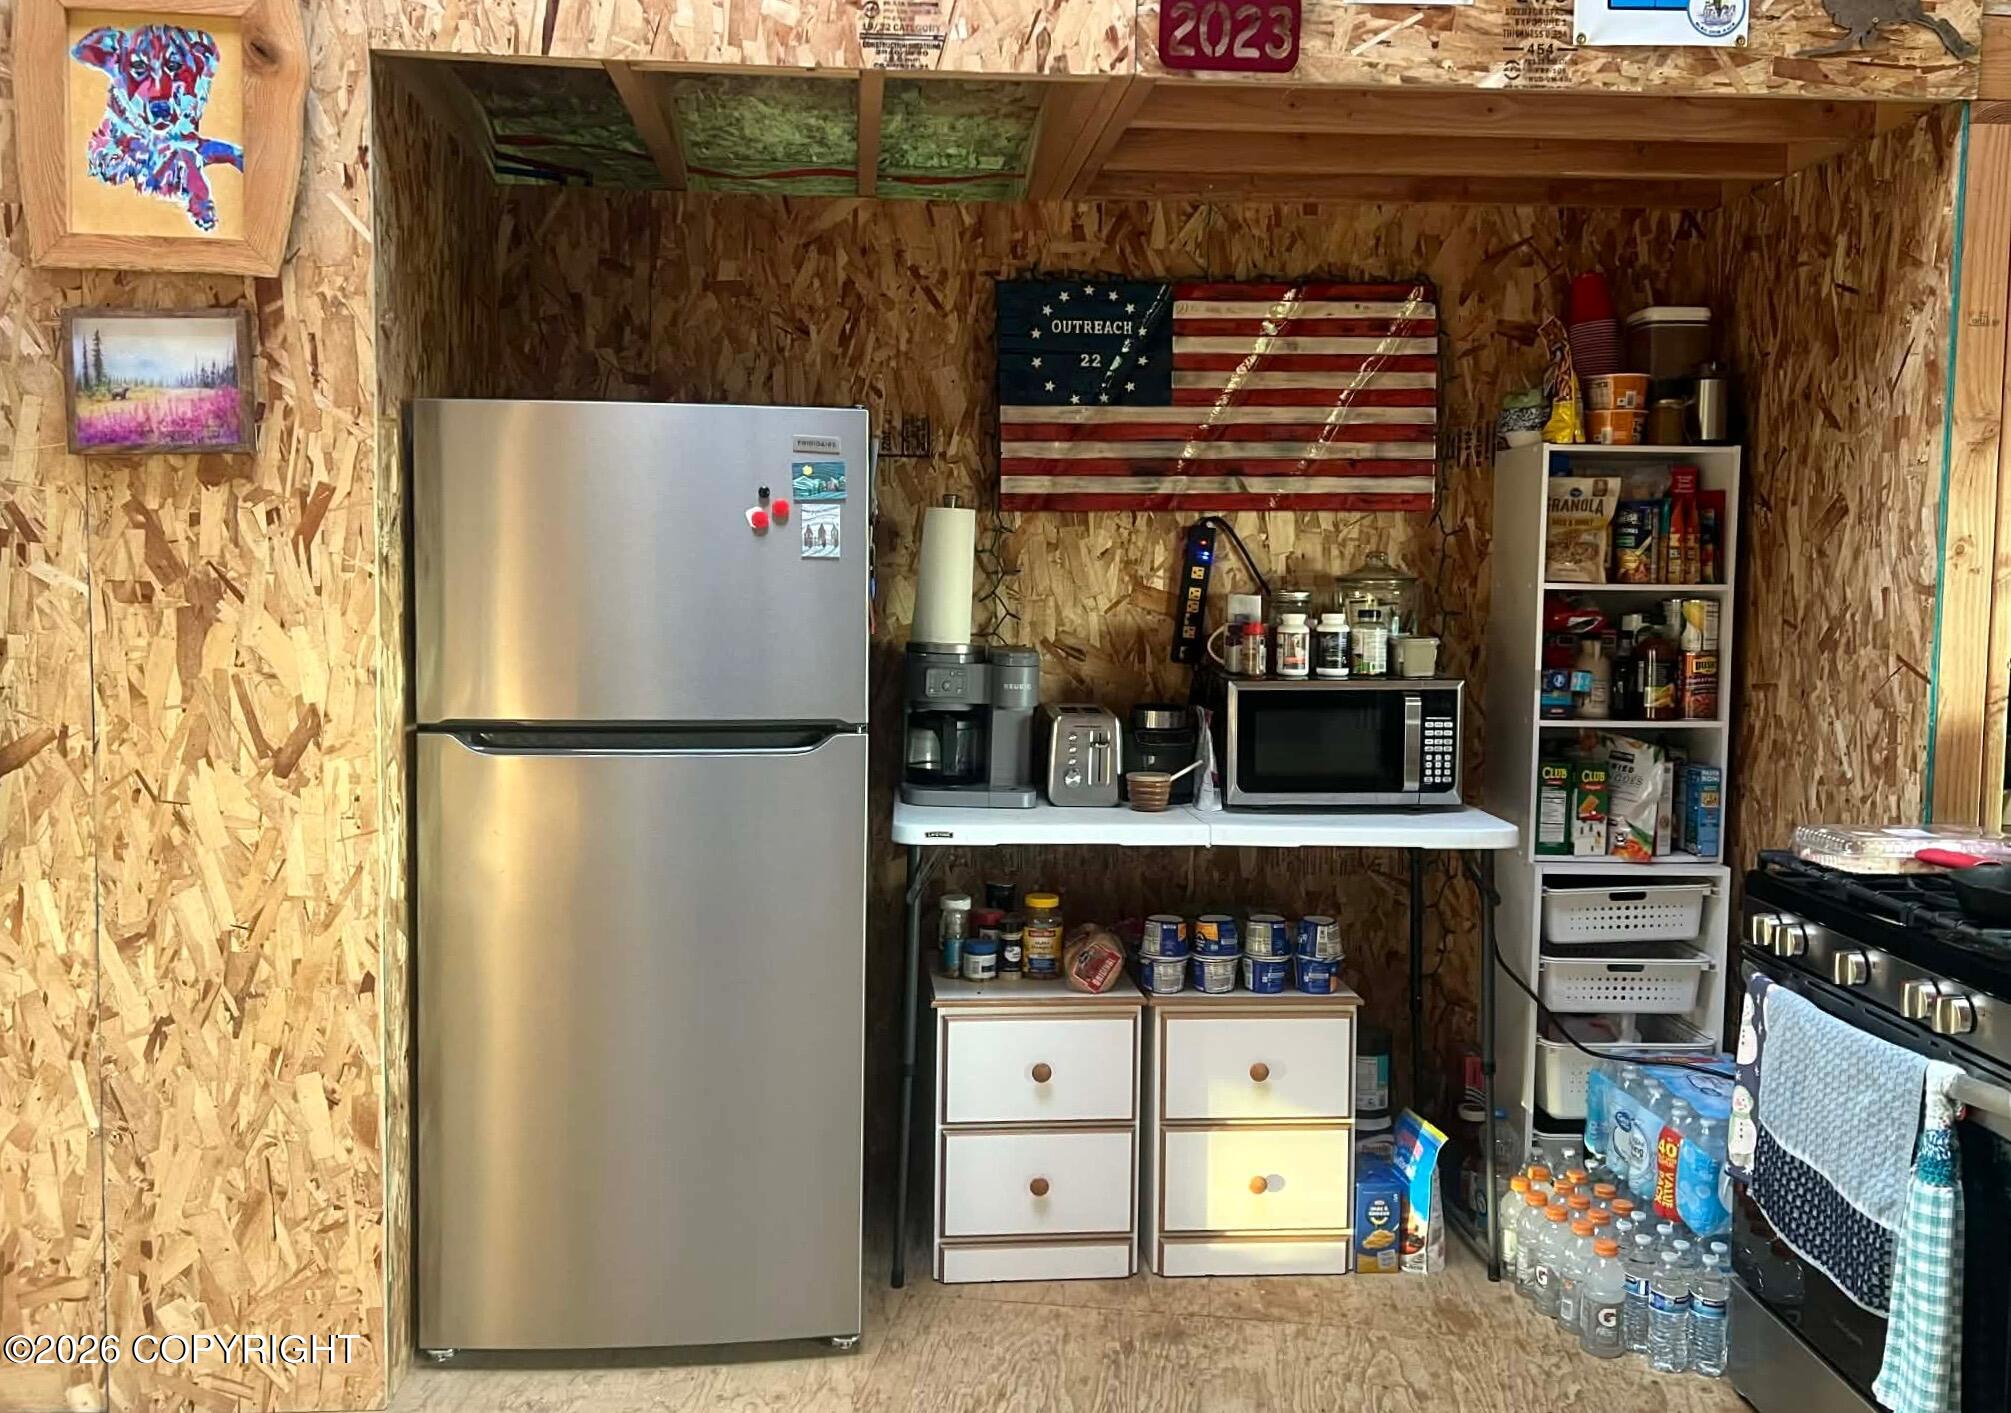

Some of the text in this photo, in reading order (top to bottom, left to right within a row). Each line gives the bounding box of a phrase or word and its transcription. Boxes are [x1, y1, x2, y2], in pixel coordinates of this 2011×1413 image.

[1168, 2, 1293, 59] 2023
[1526, 43, 1554, 55] 454
[1051, 319, 1133, 335] OUTREACH
[1080, 353, 1101, 367] 22
[1542, 766, 1567, 779] CLUB
[1581, 770, 1606, 782] CLUB
[1661, 1172, 1675, 1208] VALUE
[1535, 1265, 1549, 1288] G
[1598, 1308, 1618, 1328] G
